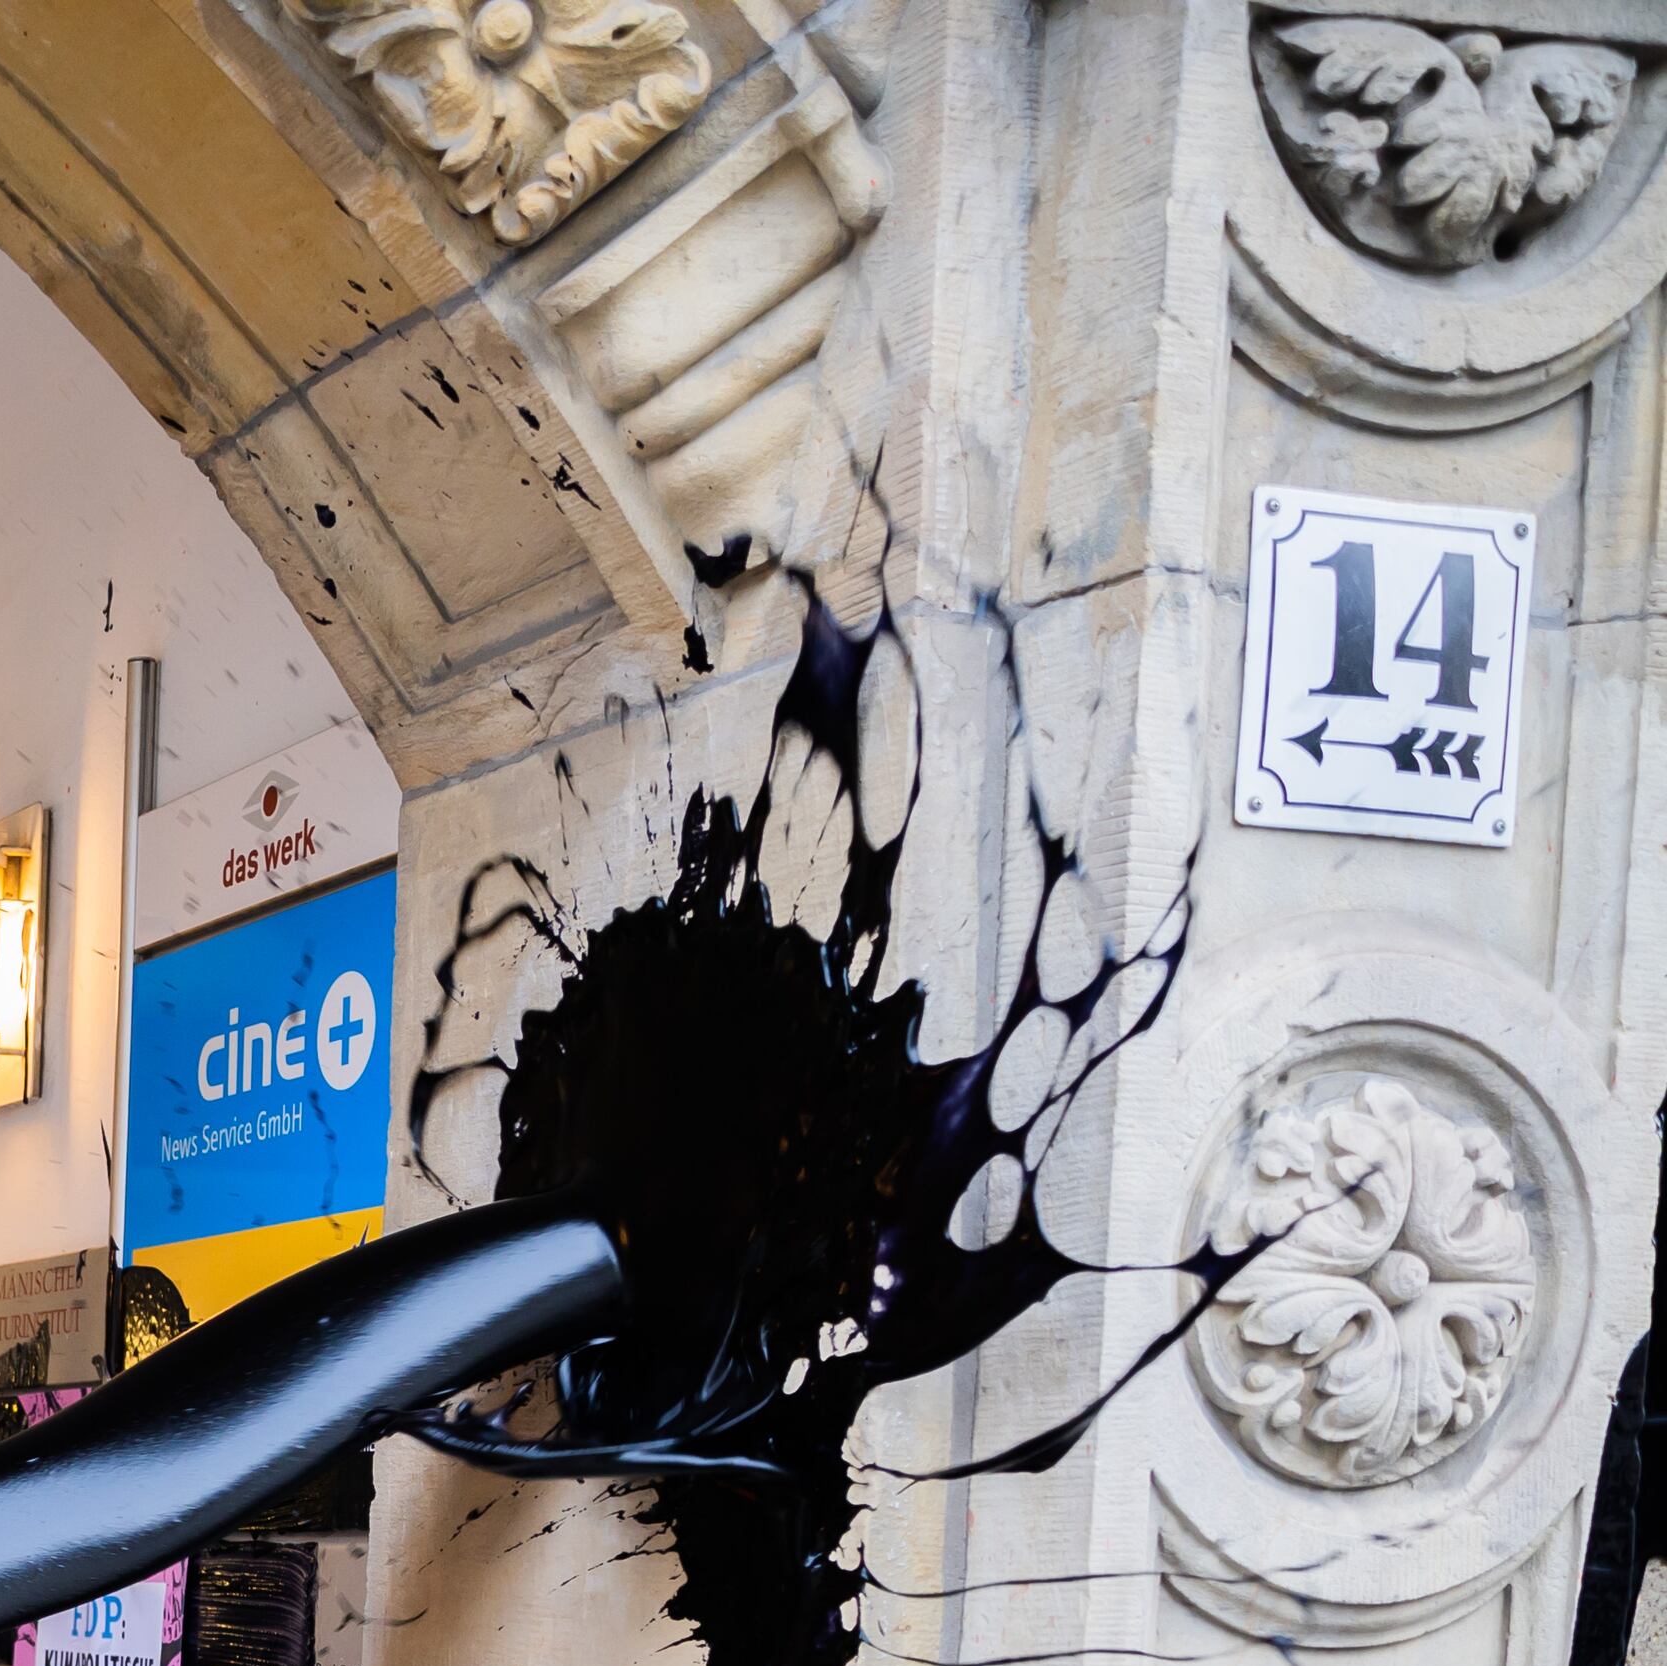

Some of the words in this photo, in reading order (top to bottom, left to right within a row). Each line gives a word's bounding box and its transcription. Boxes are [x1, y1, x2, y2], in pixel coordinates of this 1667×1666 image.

[1308, 541, 1491, 713] 14
[222, 845, 259, 889] das
[265, 819, 316, 872] werk
[161, 1134, 197, 1163] News
[202, 1119, 252, 1154] Service
[256, 1103, 303, 1142] GmbH
